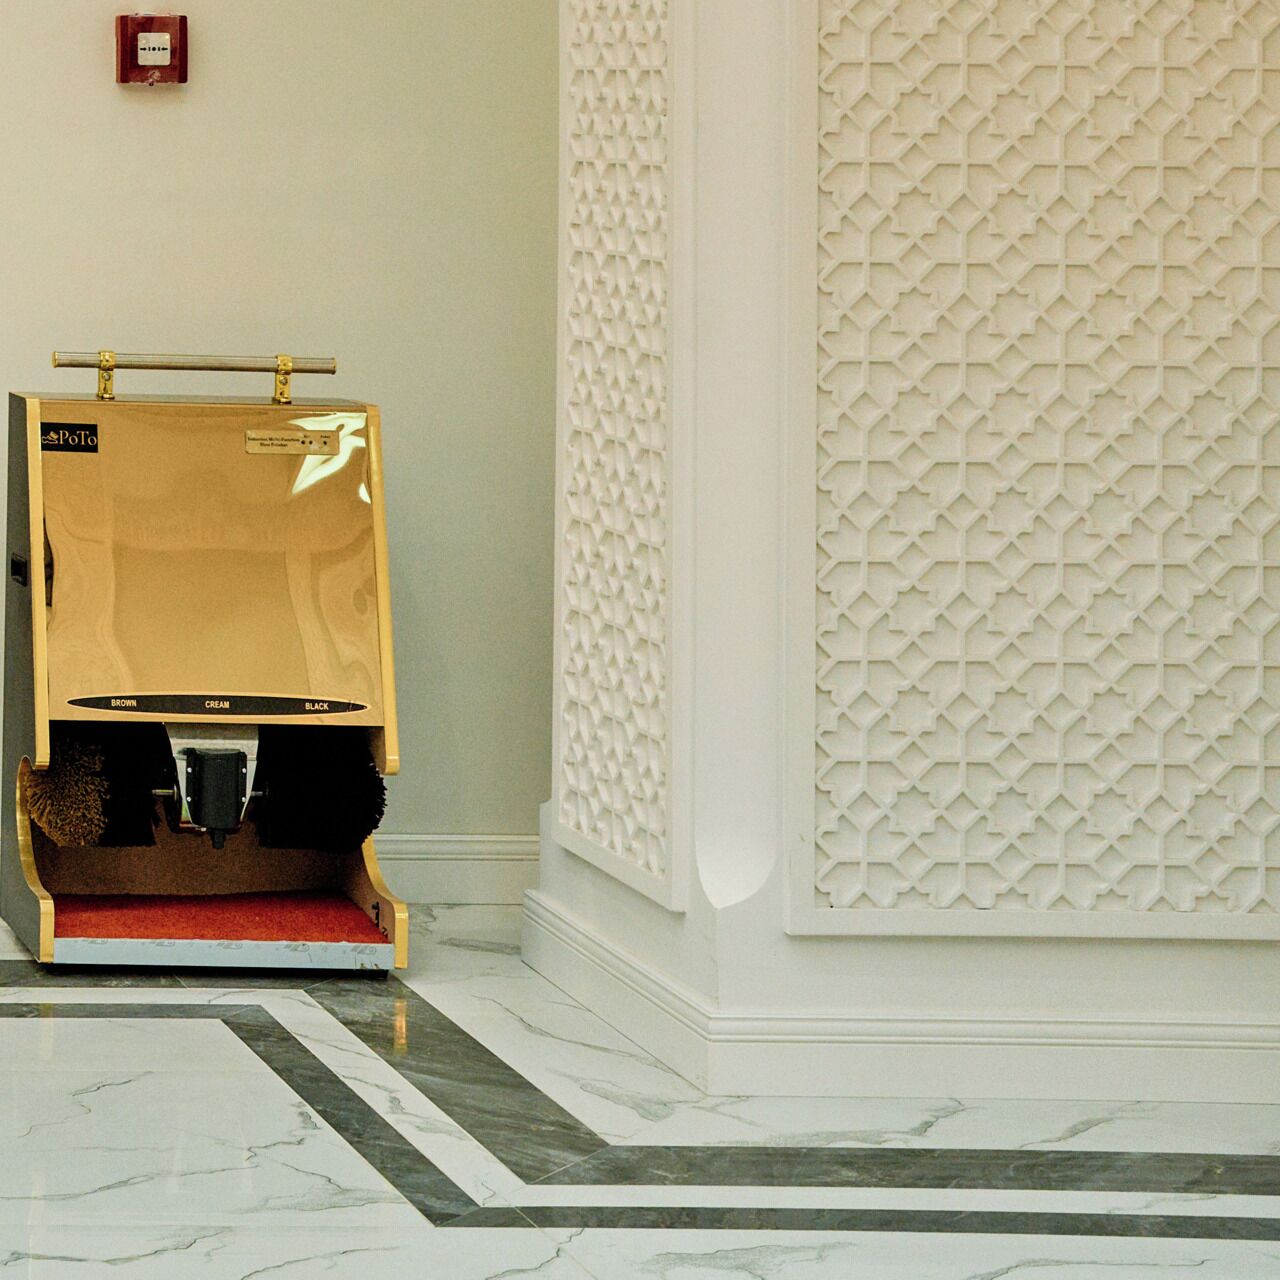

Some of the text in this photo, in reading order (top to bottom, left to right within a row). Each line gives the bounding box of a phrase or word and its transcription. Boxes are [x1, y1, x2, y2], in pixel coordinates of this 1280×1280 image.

[59, 430, 97, 446] PoTo
[111, 699, 329, 711] BROWN CREAM BLACK
